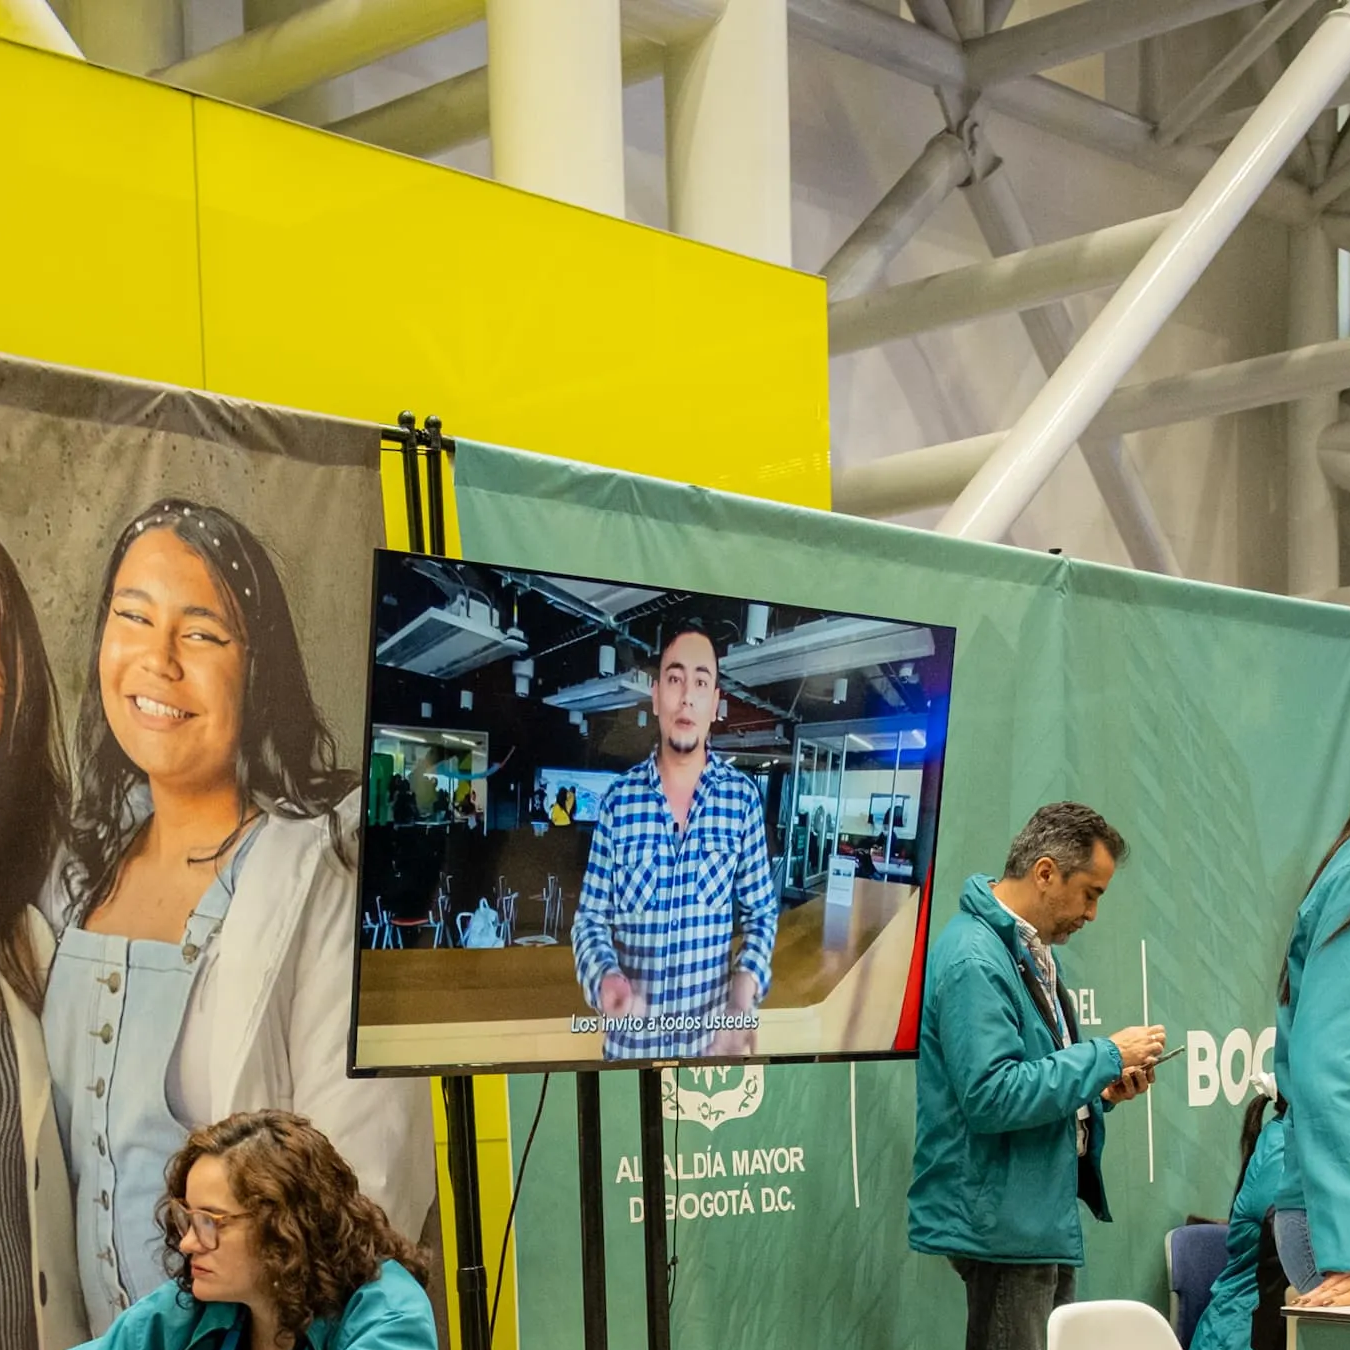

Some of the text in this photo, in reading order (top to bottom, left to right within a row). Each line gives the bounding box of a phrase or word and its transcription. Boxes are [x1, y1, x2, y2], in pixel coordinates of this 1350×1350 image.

[570, 1011, 760, 1033] Los invito a todos ustedes
[615, 1144, 806, 1184] ALALDÍA MAYOR
[760, 1185, 796, 1213] D.C.
